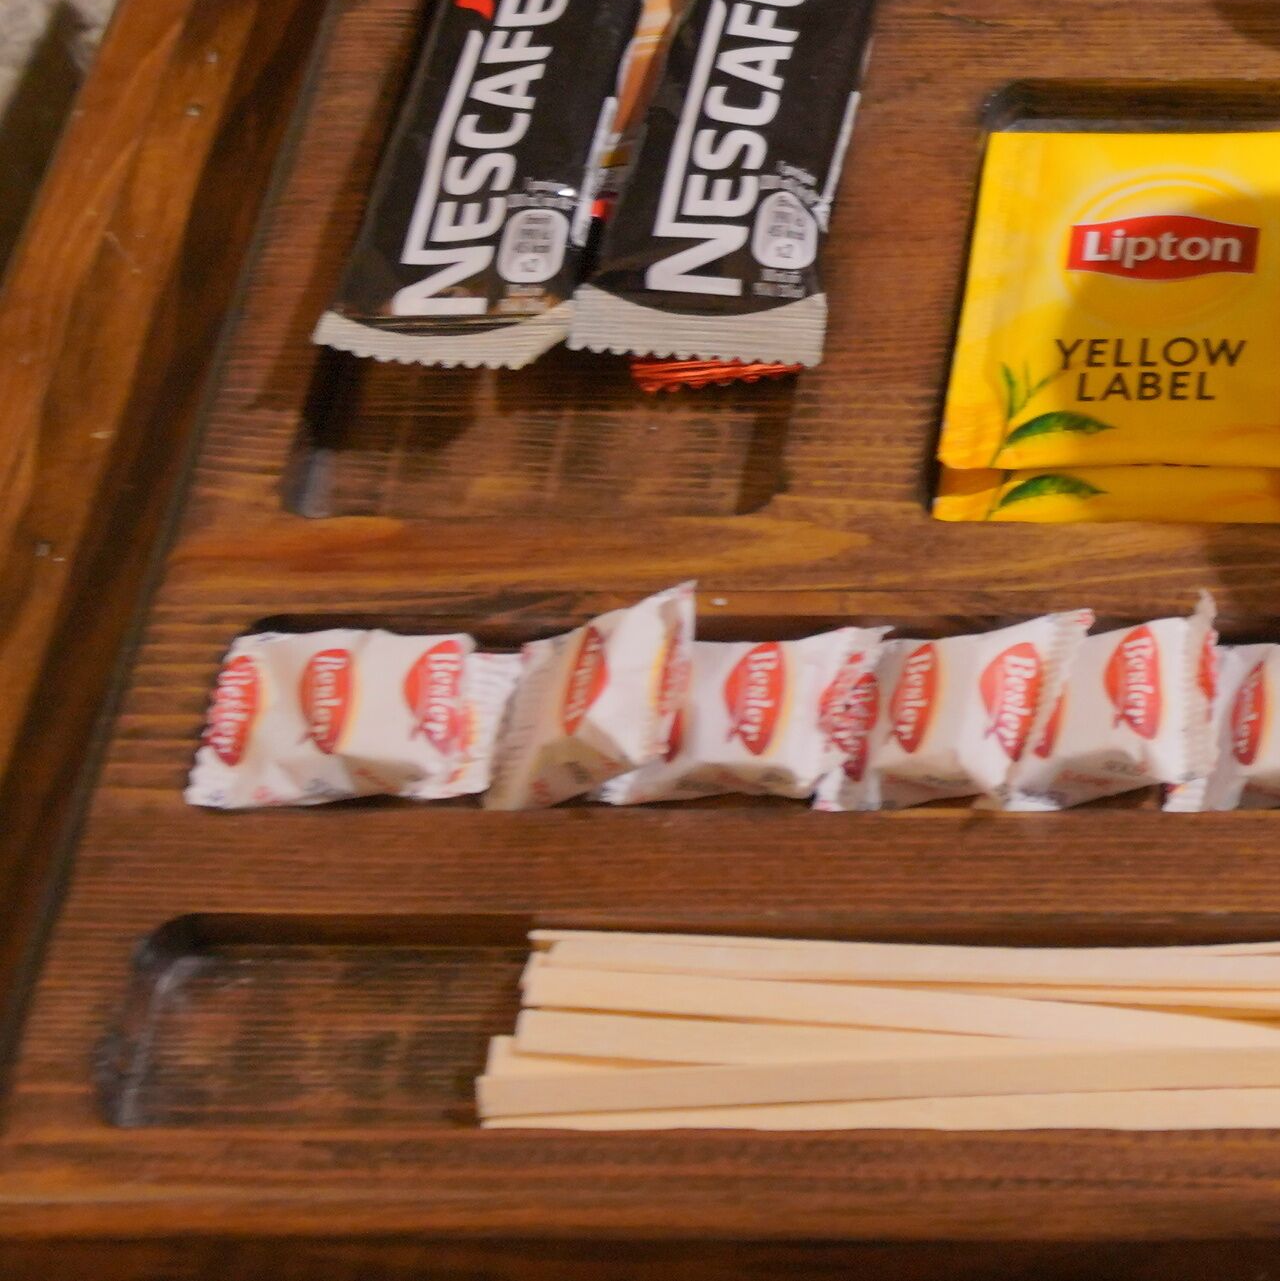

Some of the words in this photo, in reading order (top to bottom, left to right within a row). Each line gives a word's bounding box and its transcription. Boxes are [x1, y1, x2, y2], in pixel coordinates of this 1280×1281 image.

[1080, 228, 1243, 270] Lipton
[1054, 336, 1248, 371] YELLOW
[1075, 370, 1216, 403] LABEL
[740, 649, 778, 743] Besler
[895, 652, 933, 742] Besler
[998, 654, 1038, 747] Besler
[1121, 635, 1154, 726] Besler
